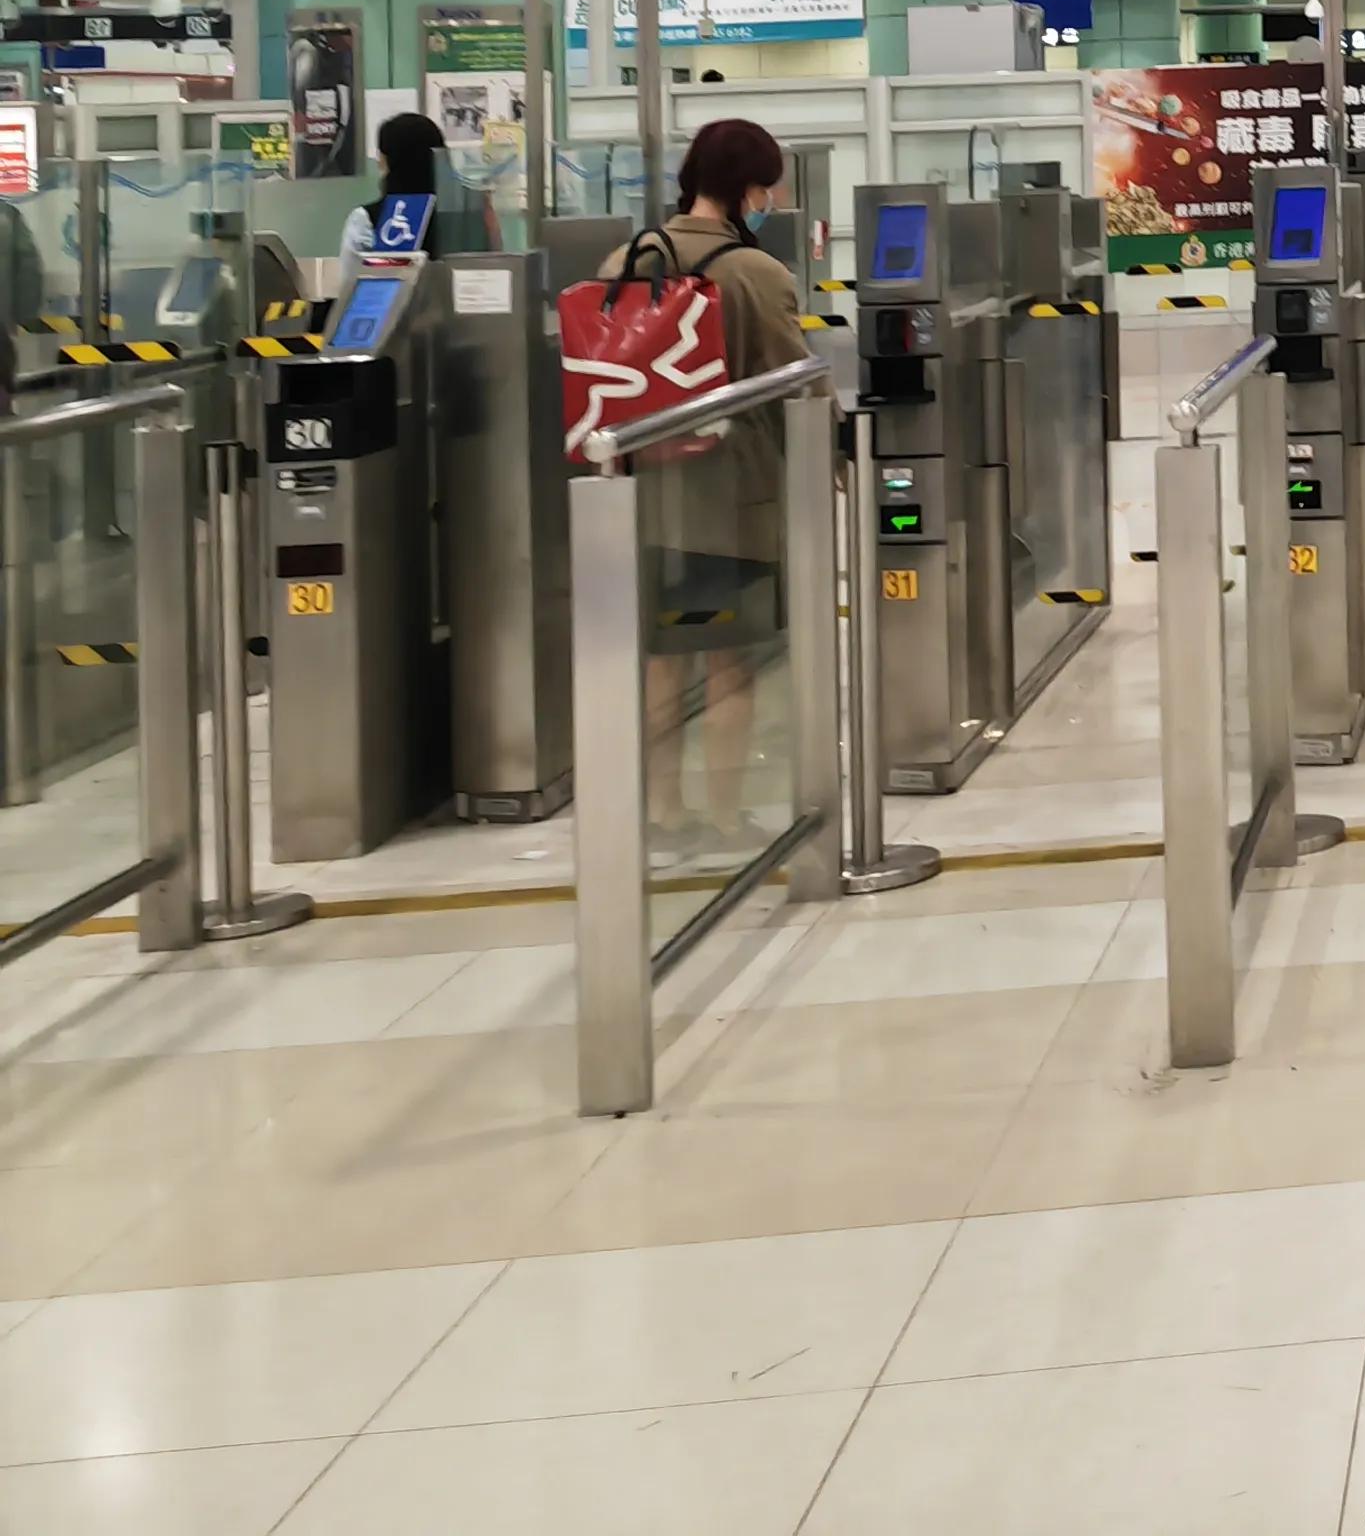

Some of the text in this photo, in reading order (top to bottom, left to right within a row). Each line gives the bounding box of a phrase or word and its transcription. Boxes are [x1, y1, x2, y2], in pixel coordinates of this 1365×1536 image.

[1213, 241, 1256, 259] 香港海
[1289, 547, 1315, 573] 32
[291, 584, 330, 612] 30
[885, 572, 915, 598] 31
